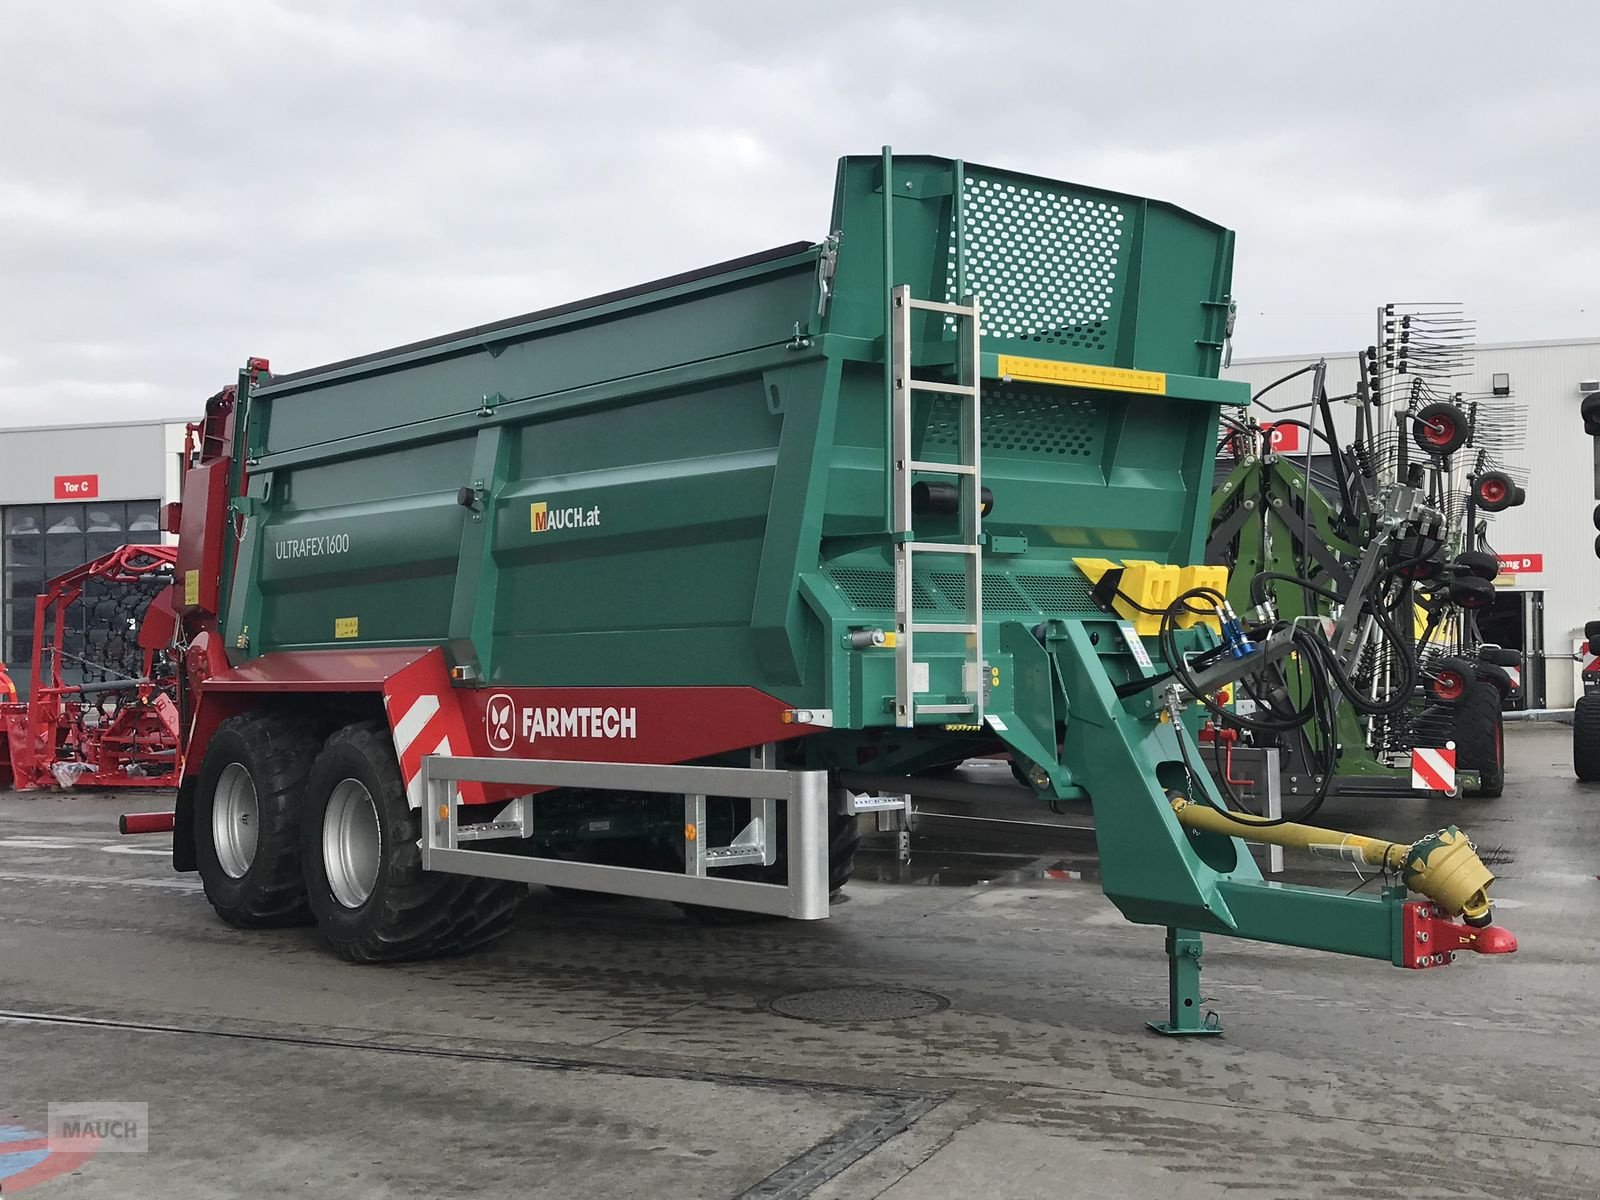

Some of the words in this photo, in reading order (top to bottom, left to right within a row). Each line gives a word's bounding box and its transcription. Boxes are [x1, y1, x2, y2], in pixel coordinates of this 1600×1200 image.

[63, 482, 79, 492] Tor
[80, 481, 88, 492] C
[535, 505, 601, 531] MAUCH.at
[275, 537, 325, 559] ULTRAFEX
[326, 533, 350, 554] 1600
[1522, 558, 1531, 568] D
[522, 706, 637, 743] FARMTECH
